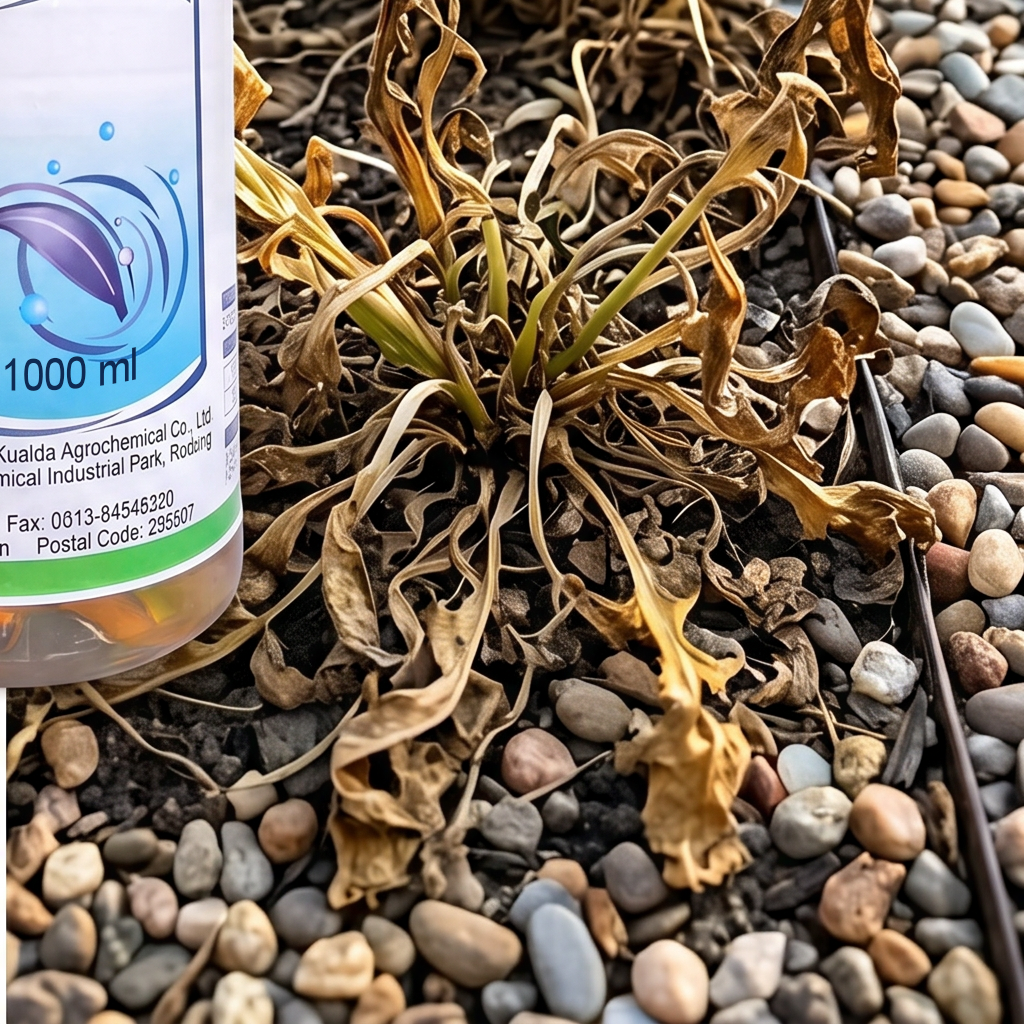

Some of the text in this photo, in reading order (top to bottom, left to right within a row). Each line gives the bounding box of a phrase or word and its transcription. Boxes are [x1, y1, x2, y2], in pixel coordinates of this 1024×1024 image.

[5, 356, 86, 392] 1000
[99, 347, 137, 386] ml
[61, 423, 167, 463] Agrochemical
[48, 456, 125, 485] Industrial
[130, 449, 166, 473] Park,
[7, 514, 46, 533] Fax:
[37, 531, 92, 555] Postal
[97, 525, 144, 548] Code:
